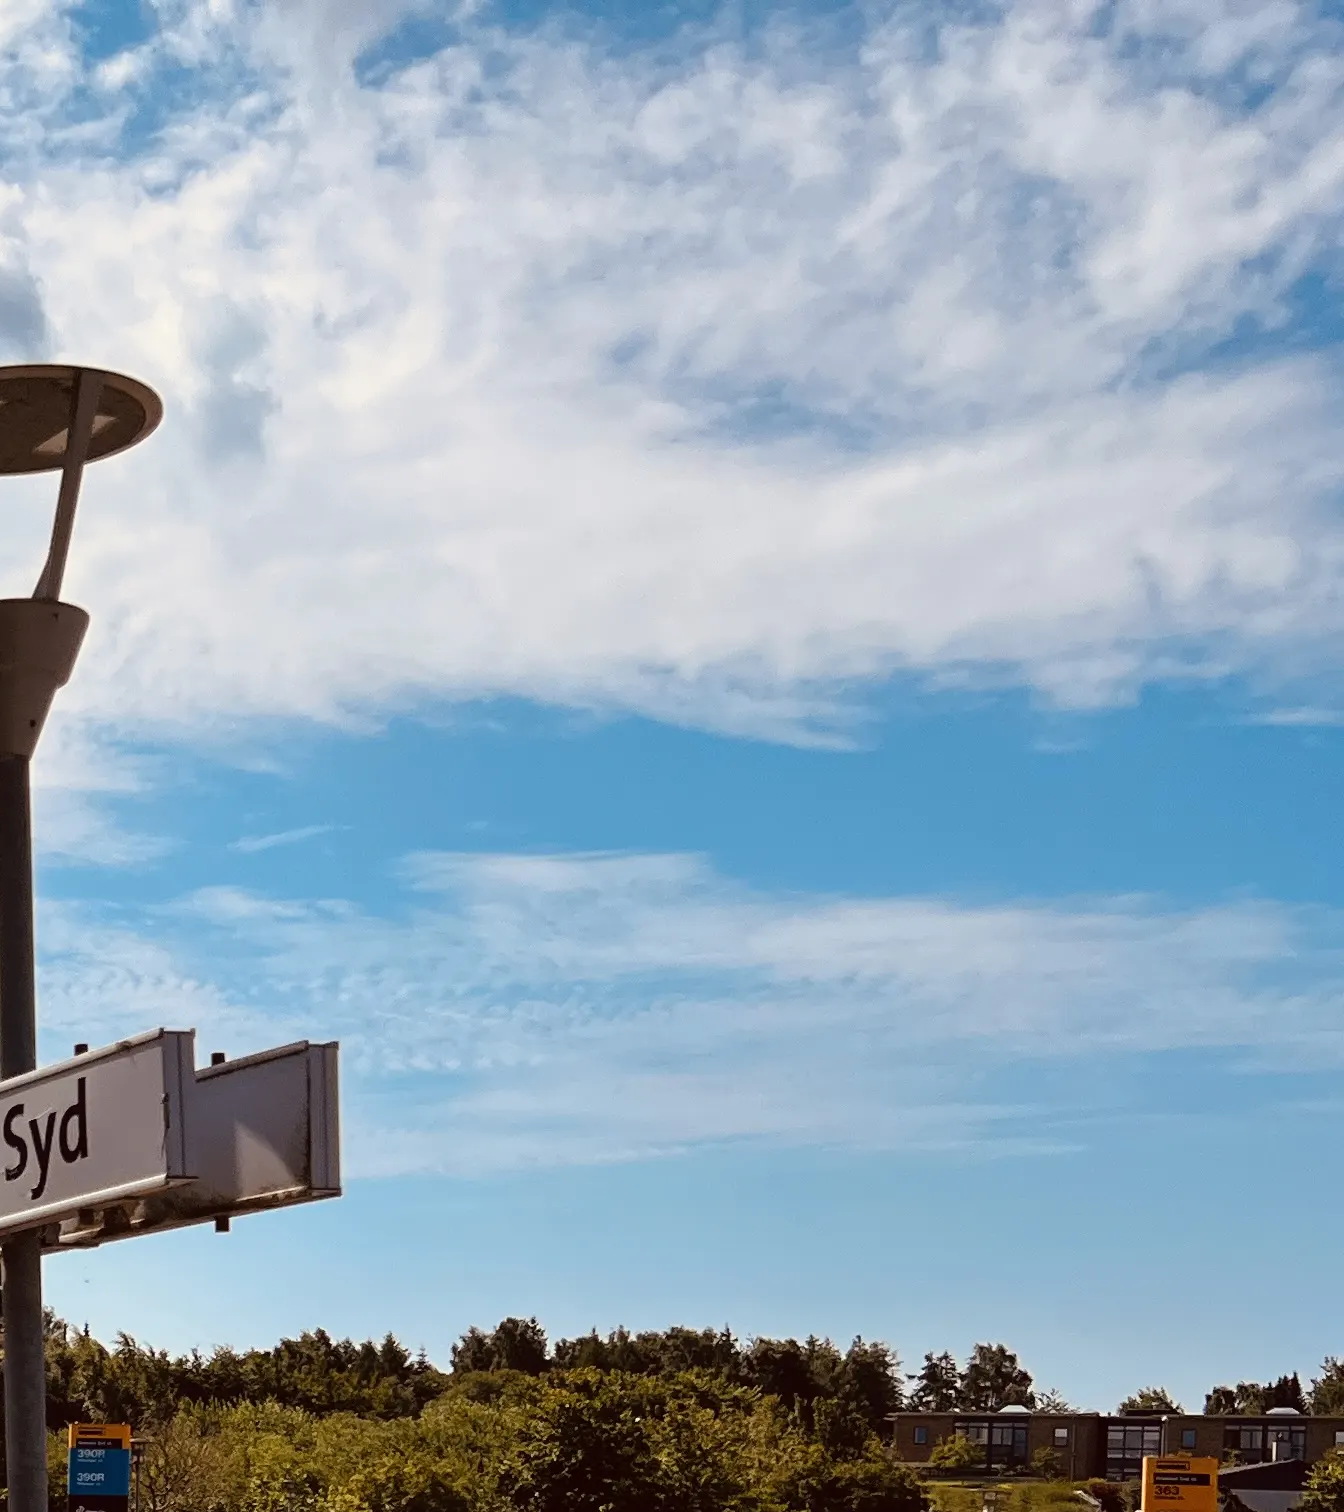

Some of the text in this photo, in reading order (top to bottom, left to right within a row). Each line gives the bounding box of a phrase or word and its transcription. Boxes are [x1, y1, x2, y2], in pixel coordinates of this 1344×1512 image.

[3, 1076, 89, 1200] Syd
[77, 1449, 105, 1458] 390R
[76, 1472, 105, 1482] 390R
